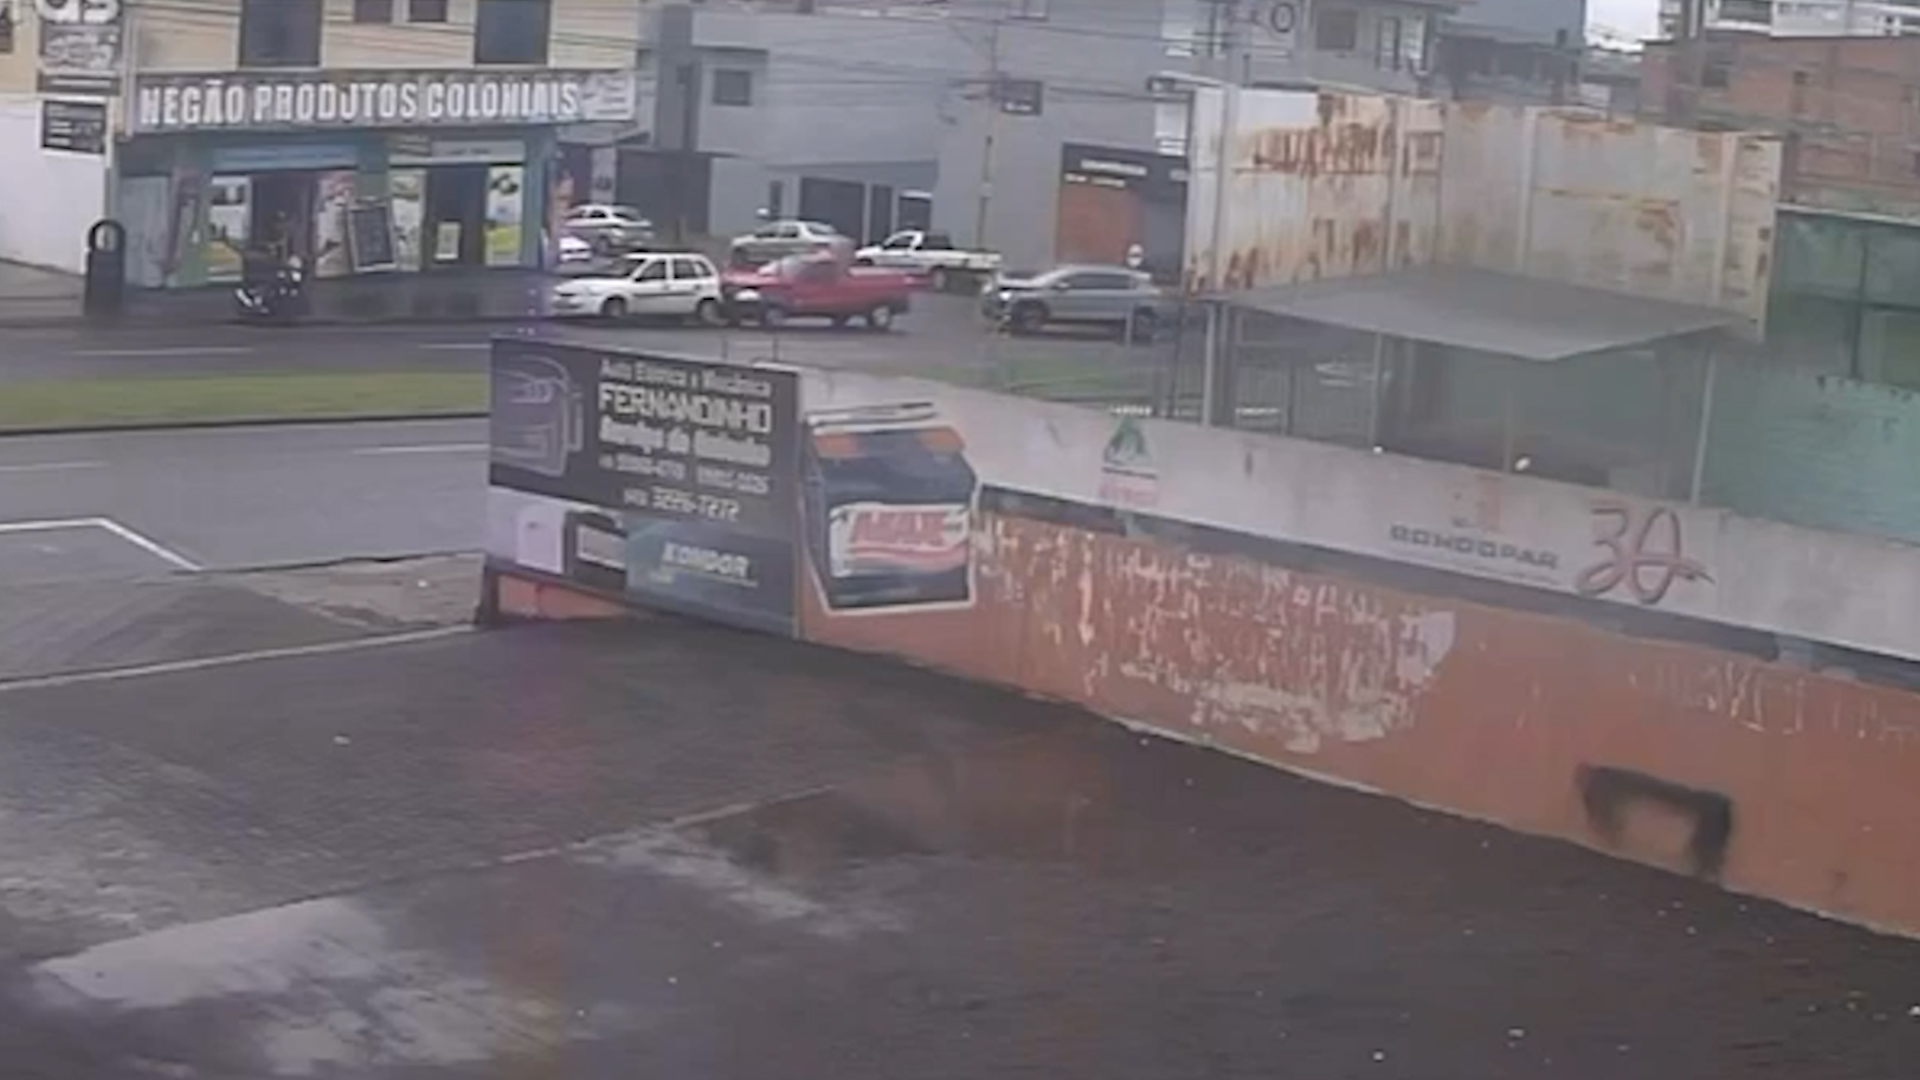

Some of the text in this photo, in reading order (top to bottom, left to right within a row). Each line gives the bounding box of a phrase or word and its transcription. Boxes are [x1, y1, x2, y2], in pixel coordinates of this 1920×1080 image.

[140, 79, 245, 124] NEGÃO
[253, 82, 417, 121] PRODUTOS
[427, 82, 579, 118] COLONIAIS
[599, 382, 771, 433] FERNANDINHO
